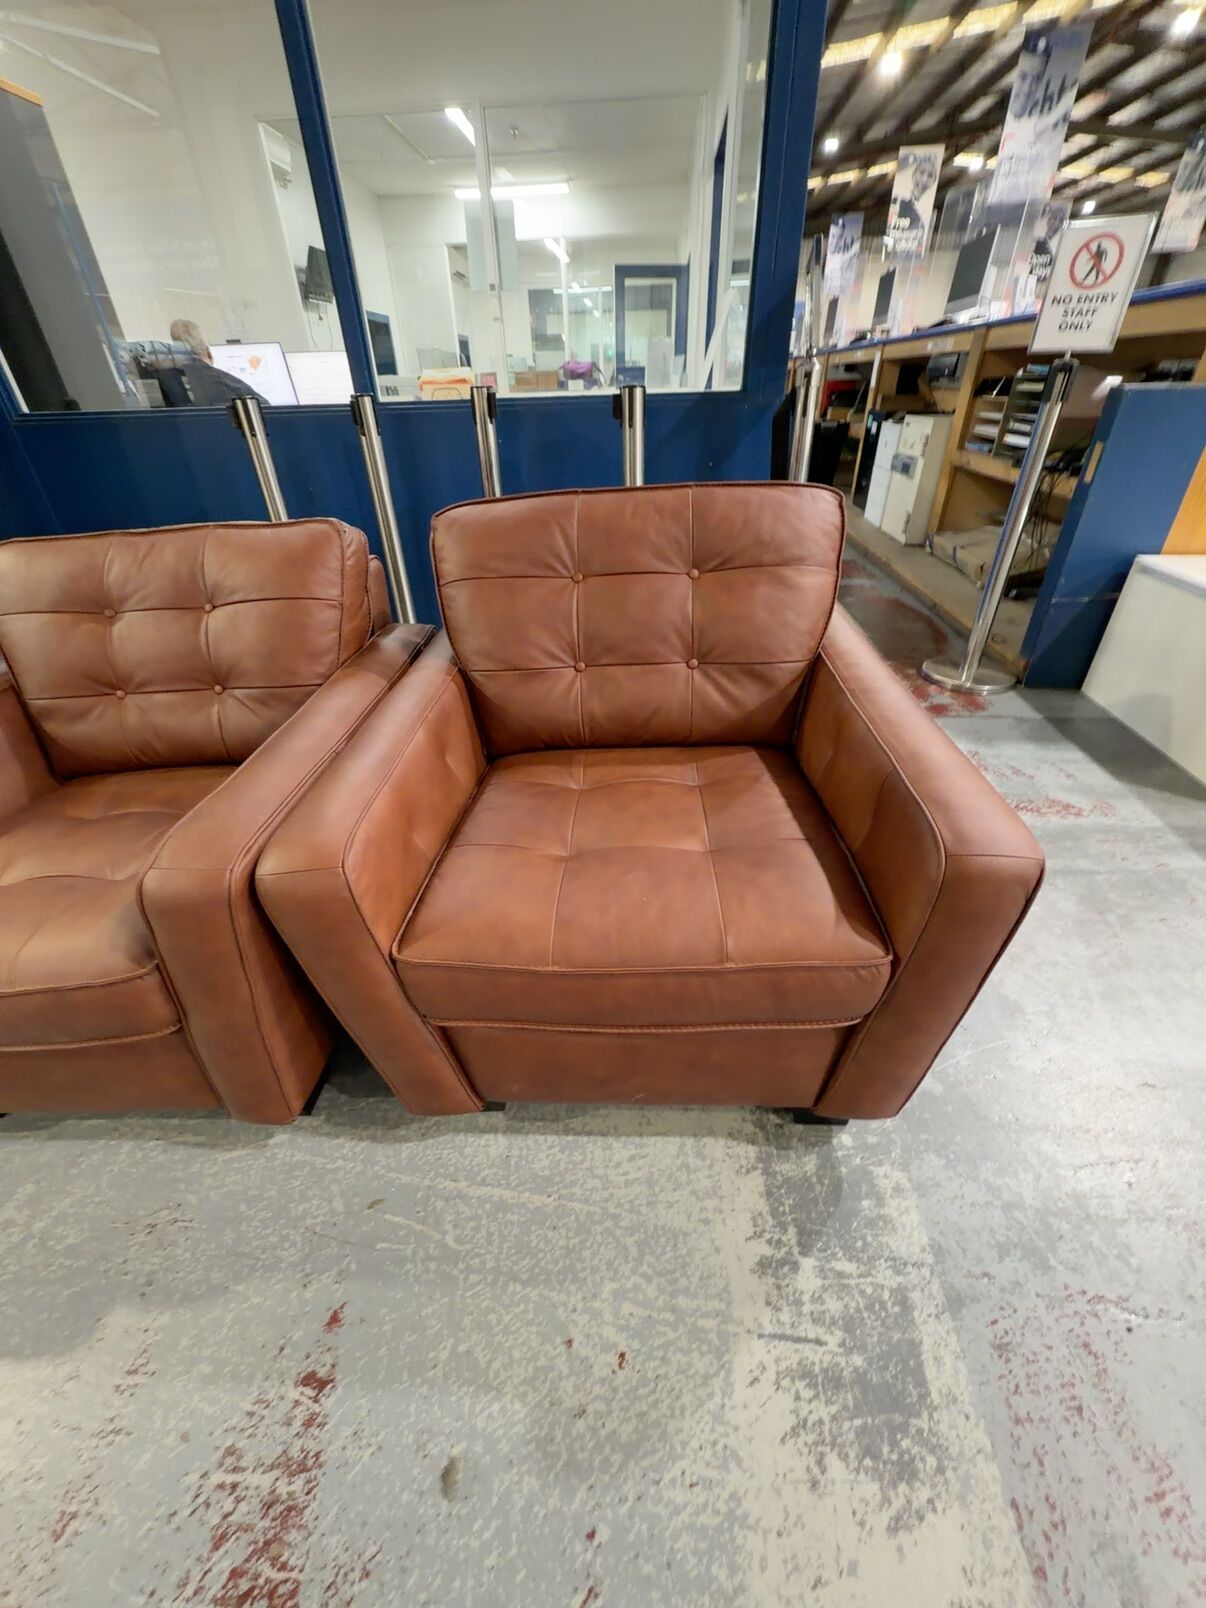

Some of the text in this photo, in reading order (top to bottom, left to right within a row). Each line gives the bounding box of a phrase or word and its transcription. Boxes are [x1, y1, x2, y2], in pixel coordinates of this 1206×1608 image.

[1051, 291, 1118, 305] NO ENTRY
[1062, 306, 1099, 318] STAFF
[1058, 319, 1094, 331] ONLY
